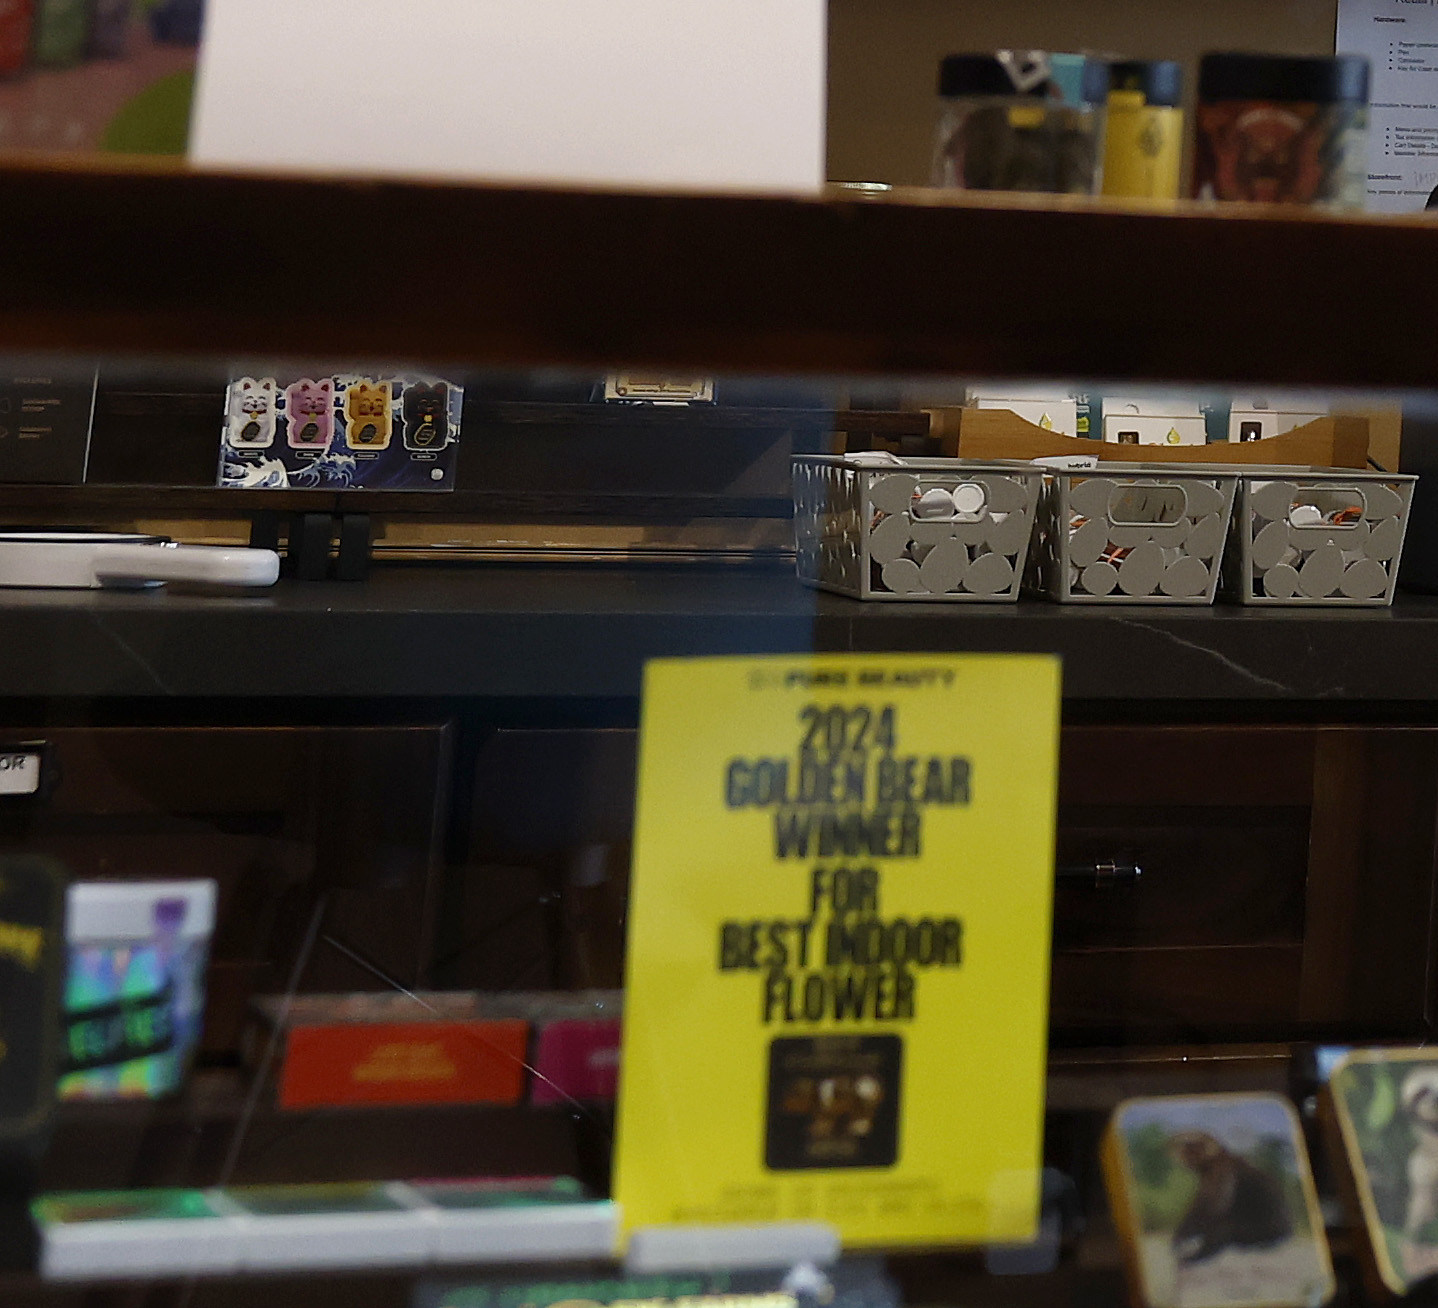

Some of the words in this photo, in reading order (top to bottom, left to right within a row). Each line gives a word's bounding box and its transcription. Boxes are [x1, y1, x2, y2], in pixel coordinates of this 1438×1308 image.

[798, 704, 898, 754] 2024
[723, 756, 867, 808] GOLDEN
[877, 756, 972, 806] BEAR
[774, 808, 923, 860] WINNER
[811, 867, 881, 913] FOR
[719, 919, 813, 973] BEST
[825, 918, 964, 967] INDOOR
[761, 970, 916, 1024] FLOWER
